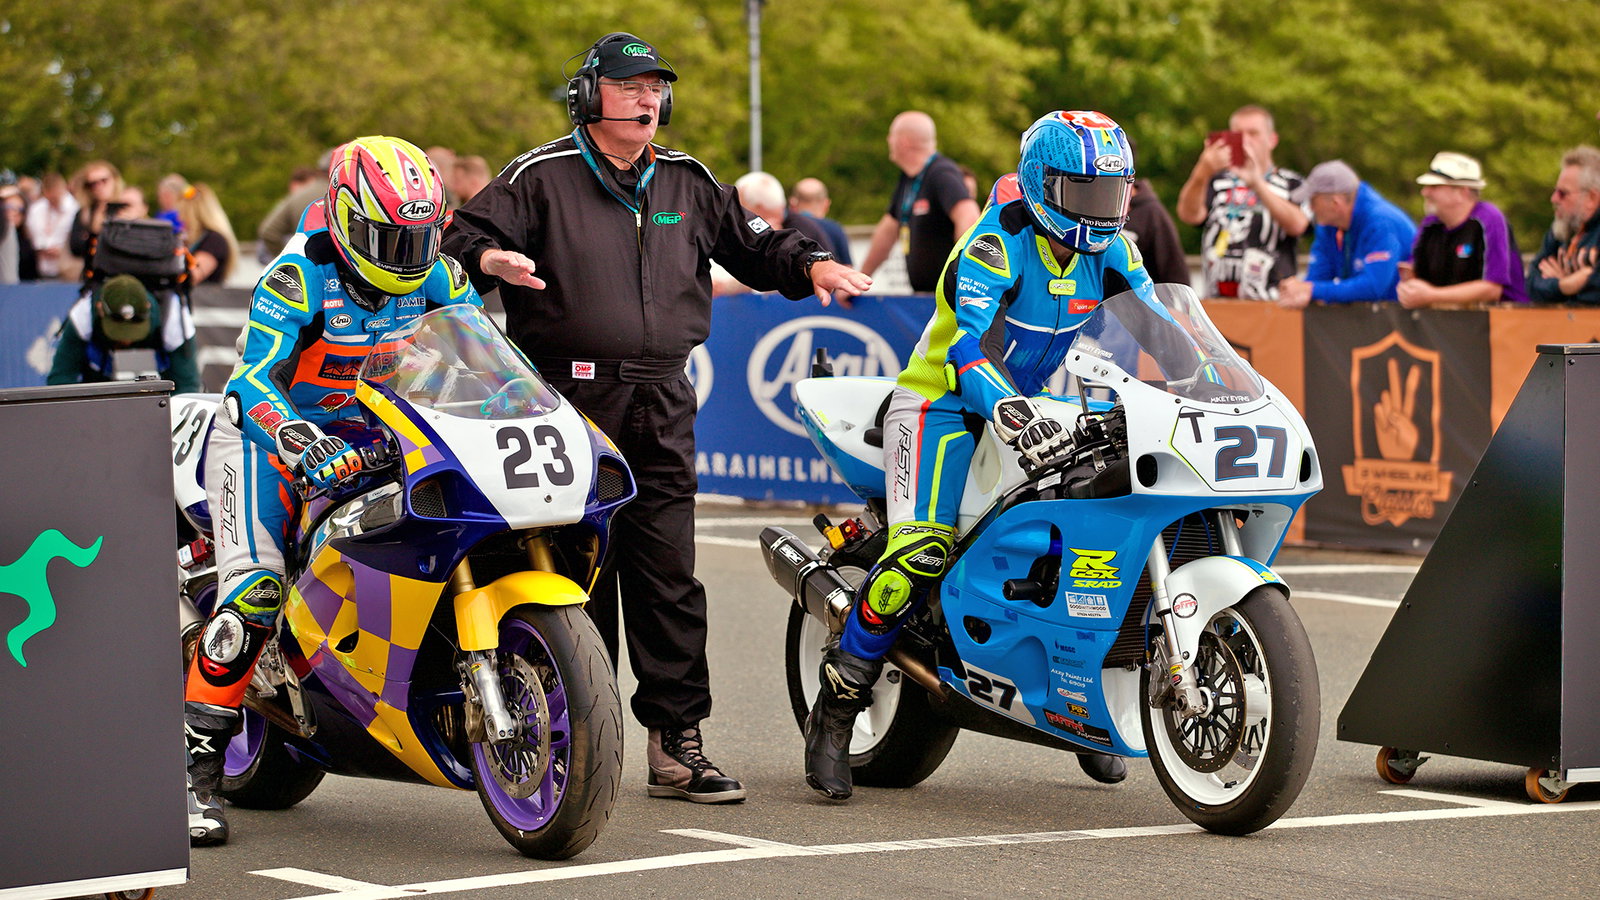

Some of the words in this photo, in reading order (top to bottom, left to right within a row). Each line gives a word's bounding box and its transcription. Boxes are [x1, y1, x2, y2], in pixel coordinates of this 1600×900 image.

[628, 46, 650, 55] MGP
[1099, 156, 1123, 168] Arai
[402, 201, 432, 216] Arai
[657, 215, 682, 225] MGP
[974, 239, 1005, 260] RST
[271, 269, 304, 293] RST
[396, 296, 426, 309] JAMIE
[254, 301, 286, 322] Kevlar
[333, 315, 350, 326] Arai
[1001, 404, 1031, 421] RST
[1179, 411, 1205, 444] T
[1214, 425, 1288, 482] 27
[496, 424, 575, 490] 23
[897, 422, 913, 500] RST
[223, 462, 239, 546] RST
[892, 525, 951, 540] RST
[908, 553, 945, 567] RST
[1068, 547, 1120, 570] R
[1069, 567, 1121, 580] GSX
[1071, 579, 1123, 589] SRAD
[244, 589, 281, 600] RST
[966, 668, 1017, 712] 27
